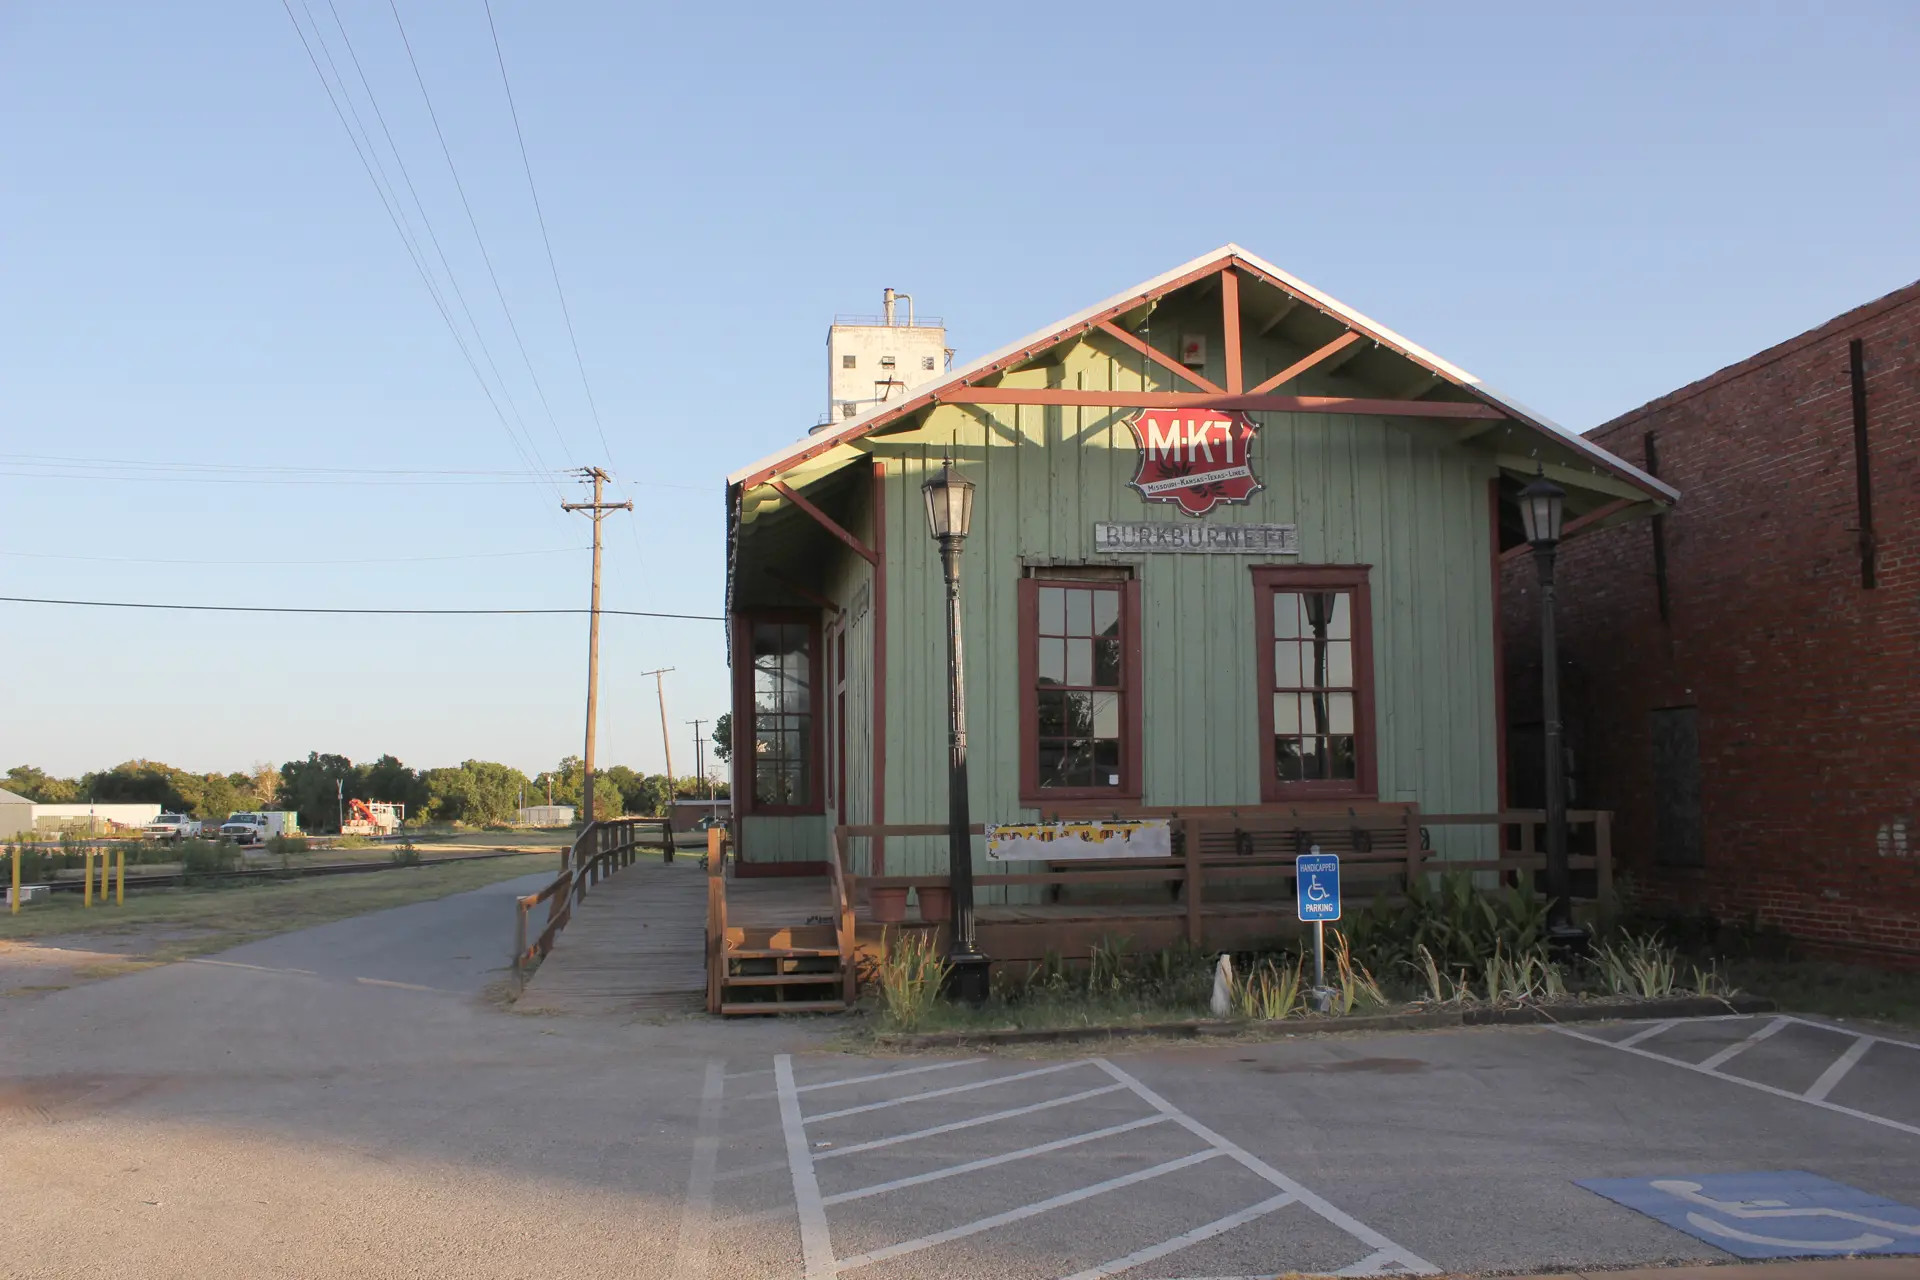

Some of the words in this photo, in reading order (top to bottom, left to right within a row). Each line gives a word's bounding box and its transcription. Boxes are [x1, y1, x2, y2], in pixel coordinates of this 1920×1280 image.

[1106, 526, 1293, 548] BURKBURNETT
[1300, 863, 1336, 872] HANDICAPPED
[1305, 903, 1333, 912] PARKING
